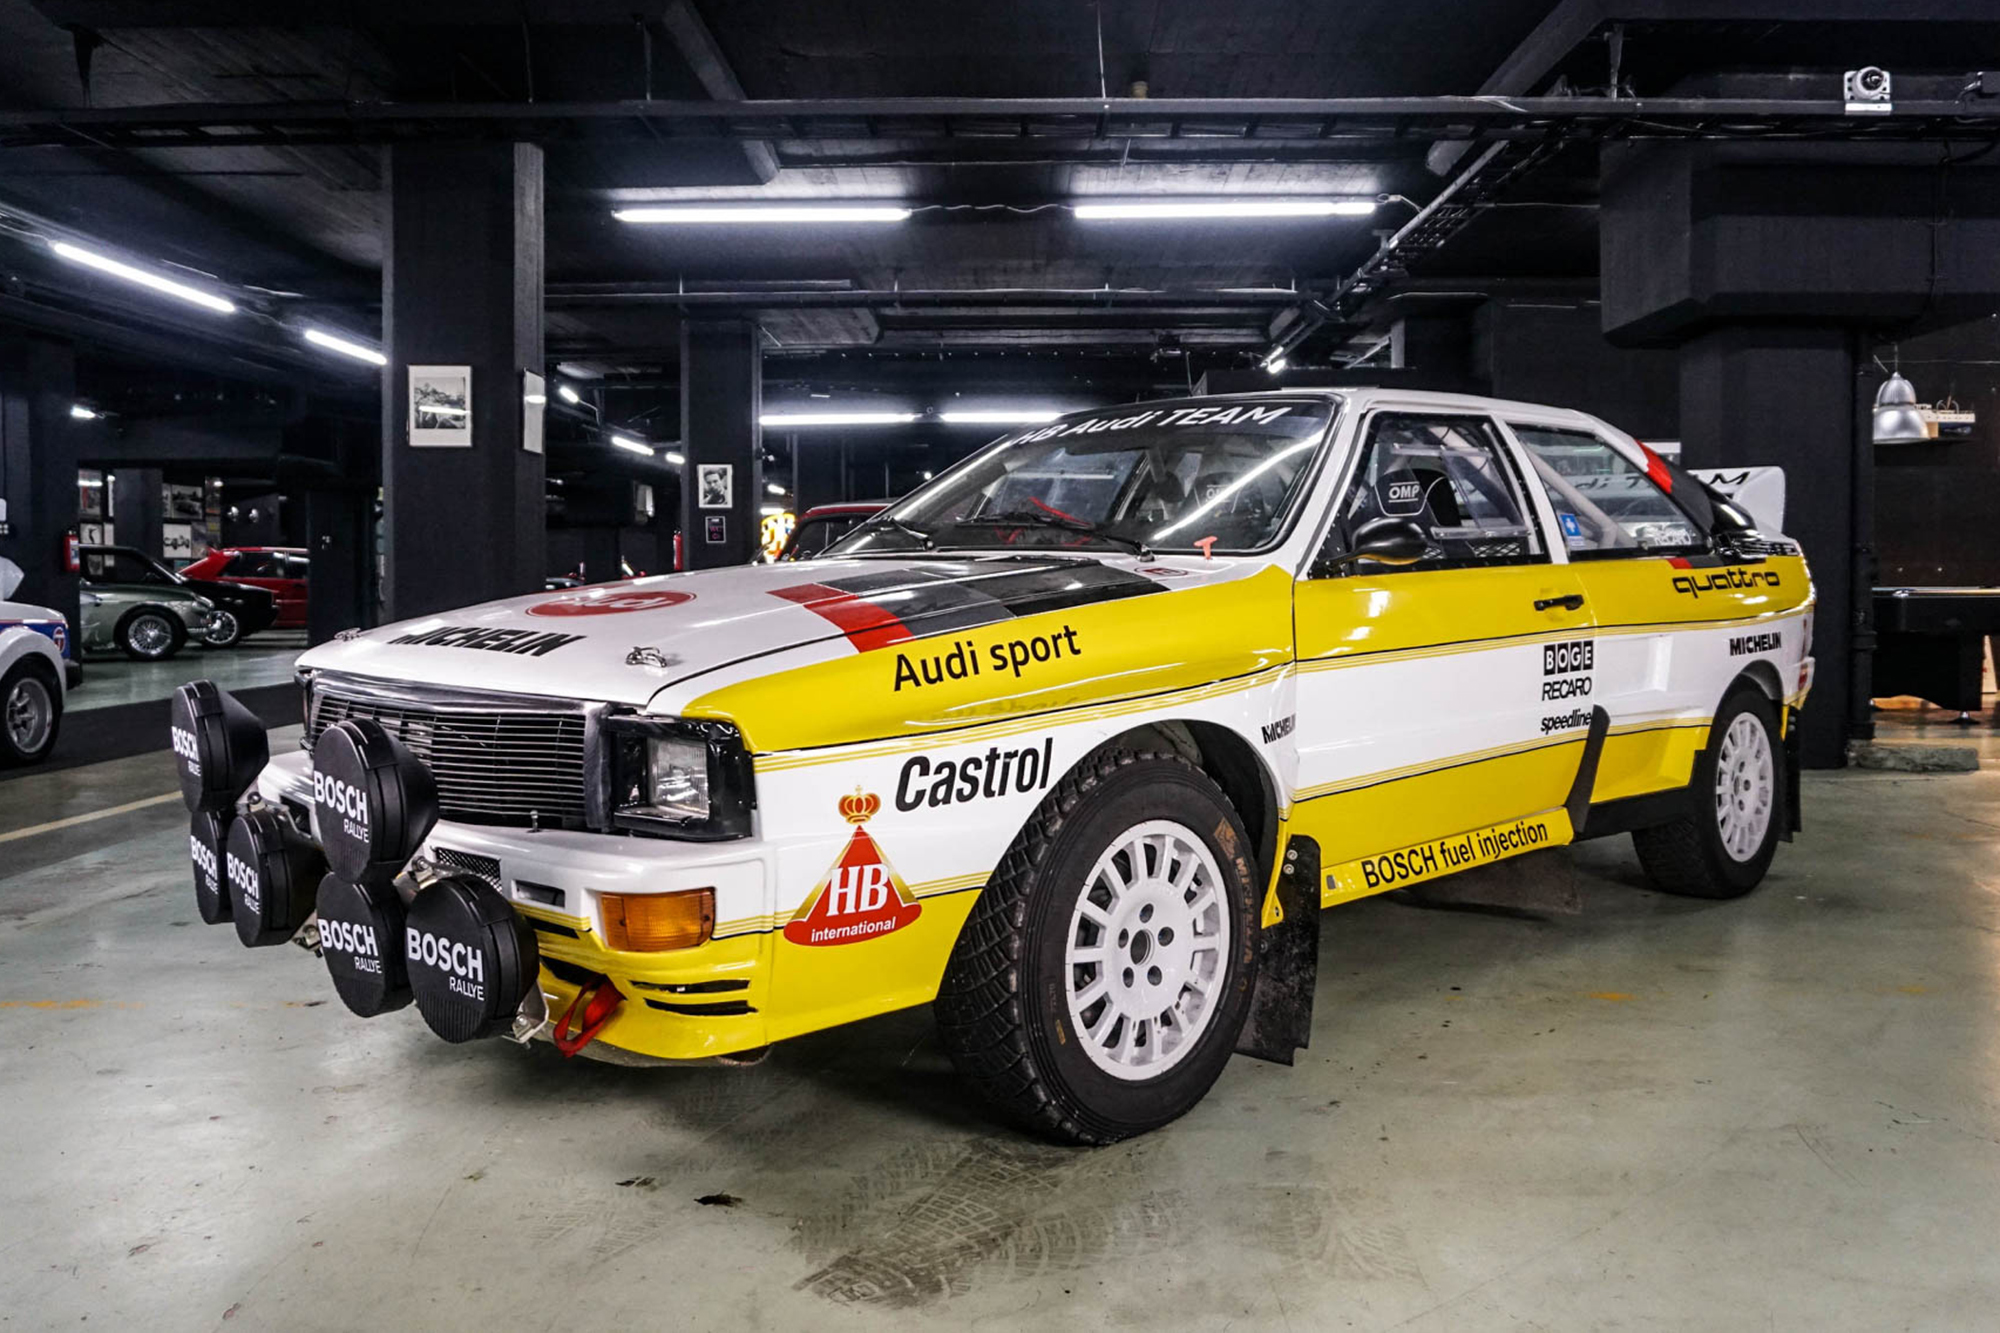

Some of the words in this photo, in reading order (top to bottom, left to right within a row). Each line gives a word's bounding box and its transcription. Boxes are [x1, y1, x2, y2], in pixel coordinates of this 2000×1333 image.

[1057, 410, 1165, 437] Audi
[1156, 406, 1293, 426] TEAM
[1388, 484, 1420, 500] OMP
[1672, 567, 1781, 599] quattro
[386, 626, 588, 658] MICHELIN
[893, 640, 981, 692] Audi
[992, 624, 1082, 678] sport
[1545, 644, 1593, 672] BOGE
[1729, 631, 1782, 657] MICHELIN
[1541, 676, 1592, 701] RECARO
[1540, 708, 1593, 735] speedline
[171, 725, 200, 762] BOSCH
[895, 737, 1053, 813] Castrol
[313, 770, 369, 825] BOSCH
[343, 818, 370, 844] RALLYE
[190, 834, 218, 881] BOSCH
[1360, 844, 1439, 889] BOSCH
[1440, 835, 1476, 868] fuel
[1476, 821, 1549, 860] injection
[226, 851, 260, 900] BOSCH
[826, 862, 891, 918] HB
[317, 918, 379, 957] BOSCH
[810, 916, 897, 944] international
[353, 955, 383, 974] RALLYE
[406, 926, 485, 983] BOSCH
[449, 975, 486, 1001] RALLYE
